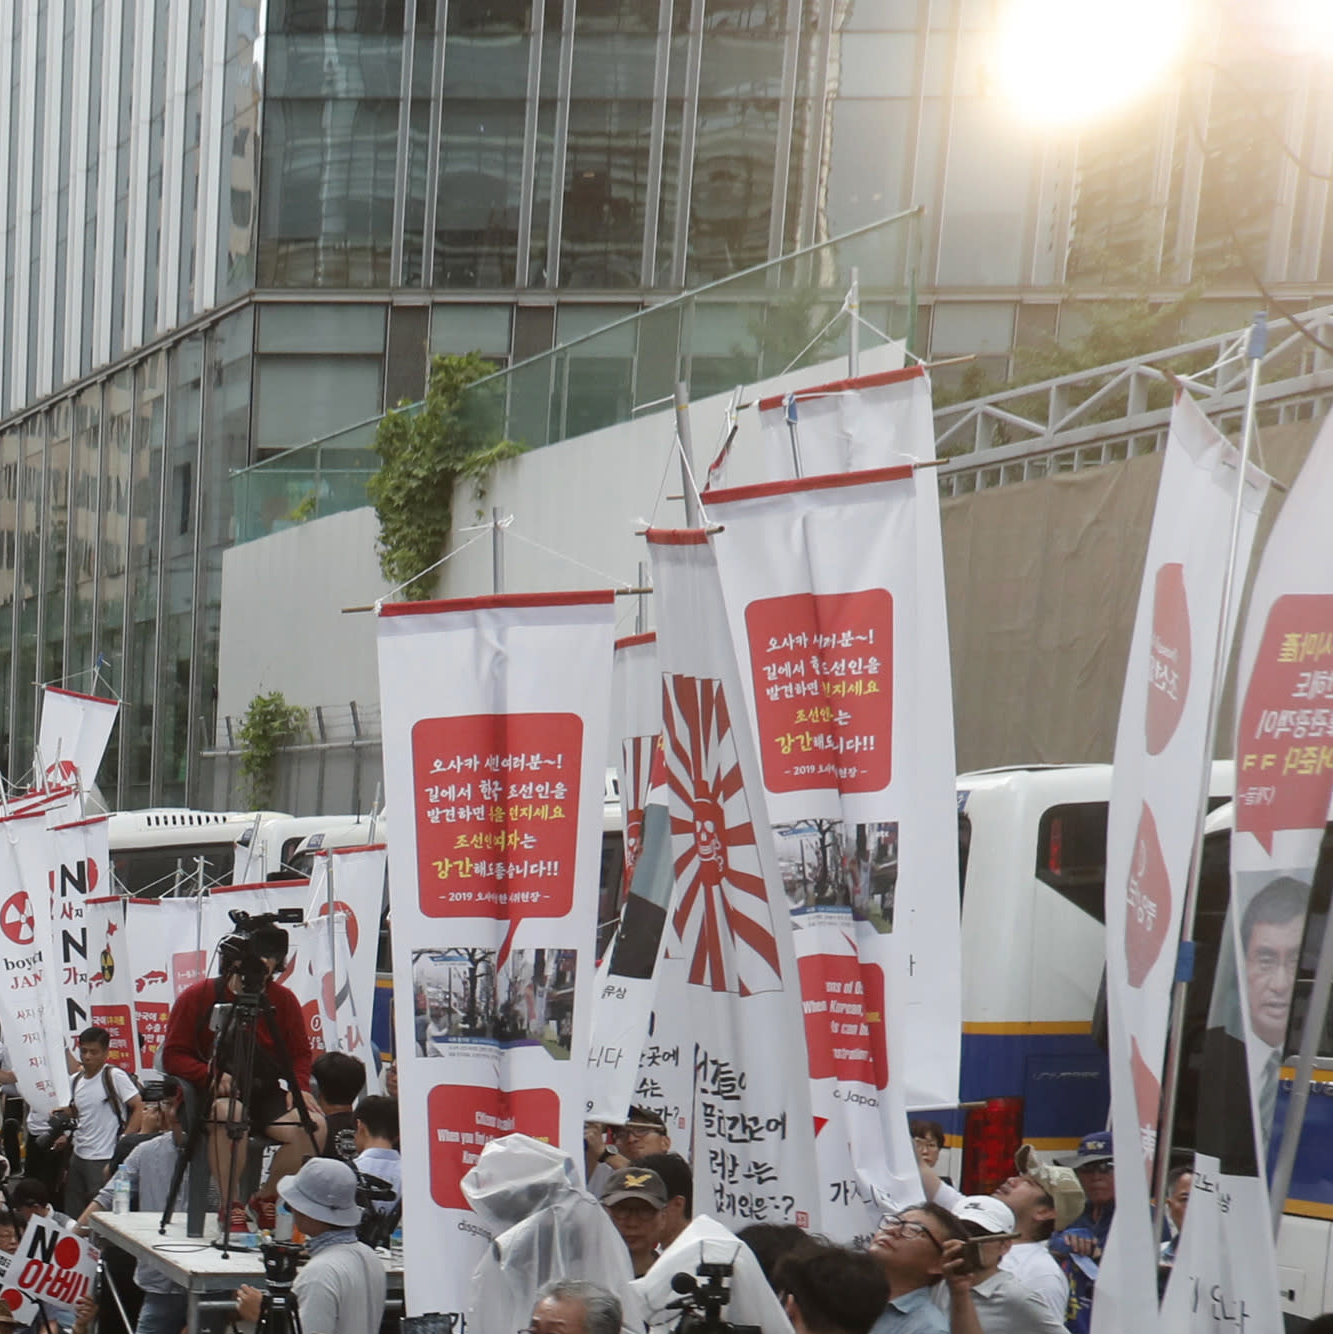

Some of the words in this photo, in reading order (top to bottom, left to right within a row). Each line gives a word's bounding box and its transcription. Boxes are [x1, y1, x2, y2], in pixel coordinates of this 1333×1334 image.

[766, 632, 809, 652] 오사카
[763, 660, 806, 681] 길에서
[766, 681, 819, 701] 발견하면
[430, 755, 479, 773] 오사카
[424, 783, 472, 803] 길에서
[507, 781, 568, 800] 조선인을
[427, 805, 485, 823] 발견하면
